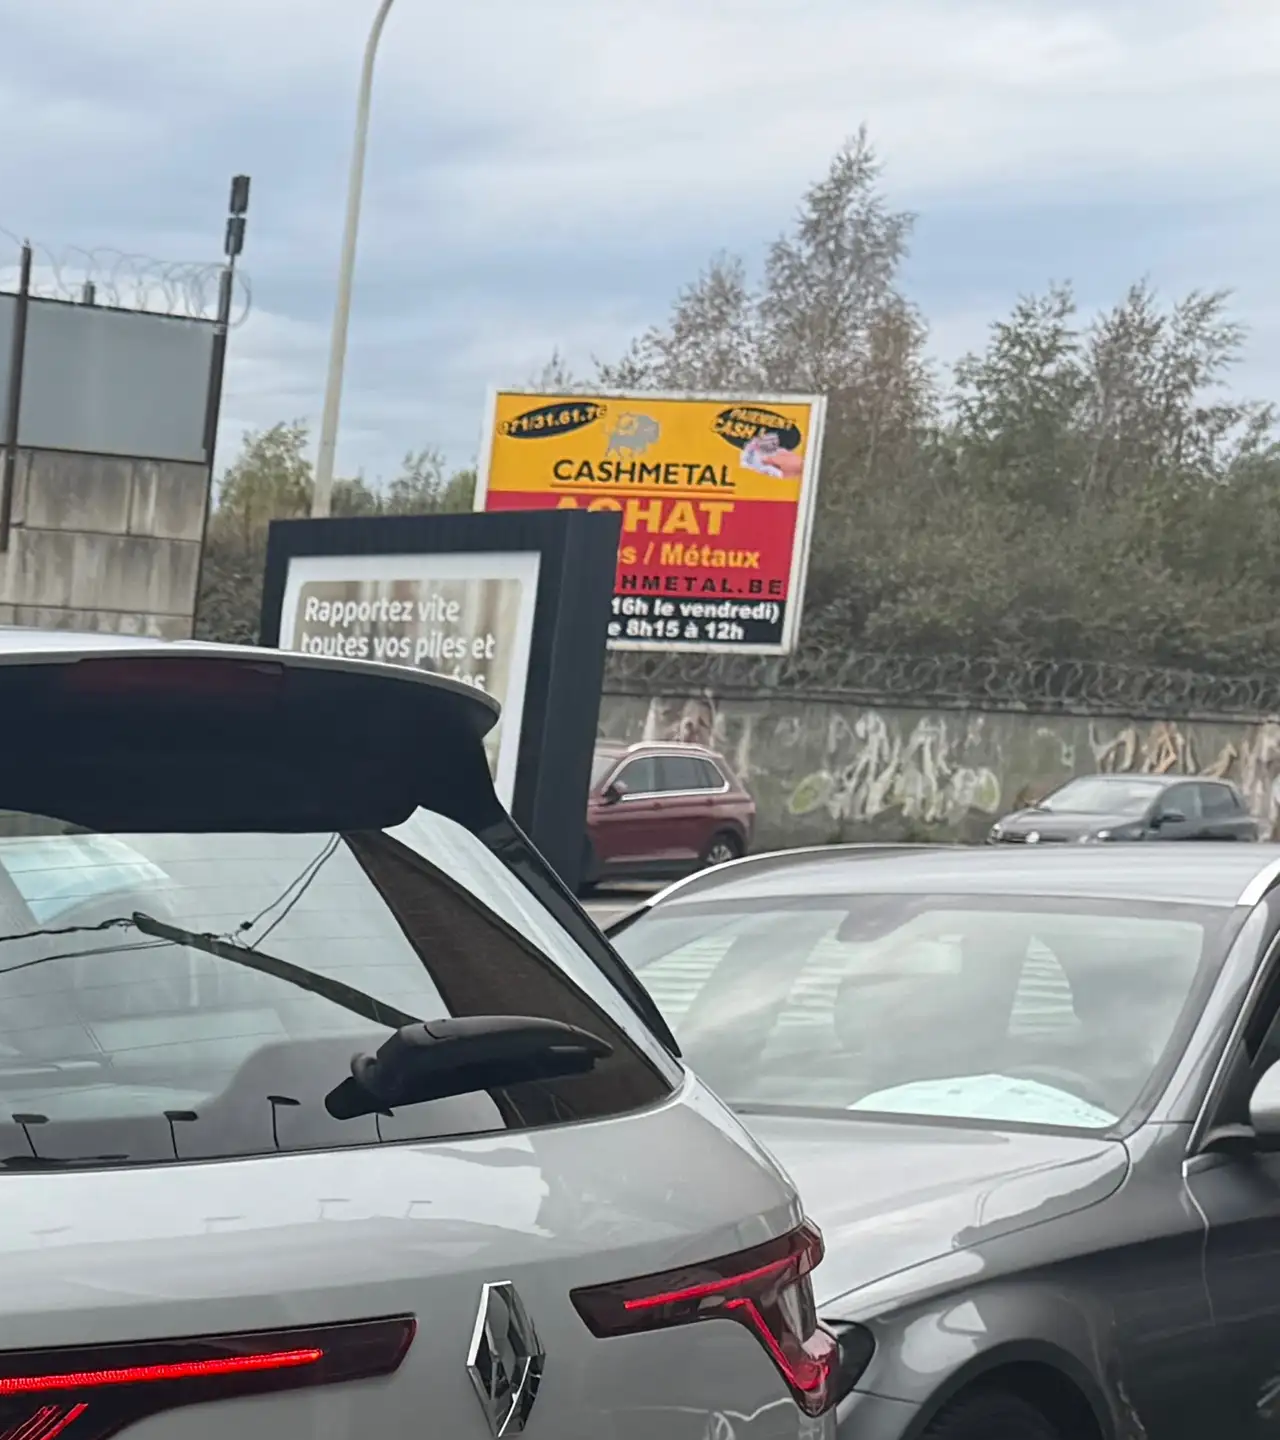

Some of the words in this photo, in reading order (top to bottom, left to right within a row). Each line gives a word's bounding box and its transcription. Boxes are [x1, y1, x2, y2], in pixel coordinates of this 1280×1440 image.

[553, 459, 736, 487] CASHMETAL
[660, 542, 760, 569] Métaux
[618, 574, 784, 595] HMETAL.BE
[304, 595, 414, 628] Rapportez
[418, 594, 461, 622] vite
[653, 598, 676, 617] le
[679, 601, 780, 624] vendredi)
[626, 619, 679, 638] 8h15
[683, 620, 699, 639] à
[705, 621, 744, 640] 12h
[301, 631, 370, 657] toutes
[373, 637, 411, 659] vos
[414, 631, 467, 664] piles
[471, 632, 496, 660] et
